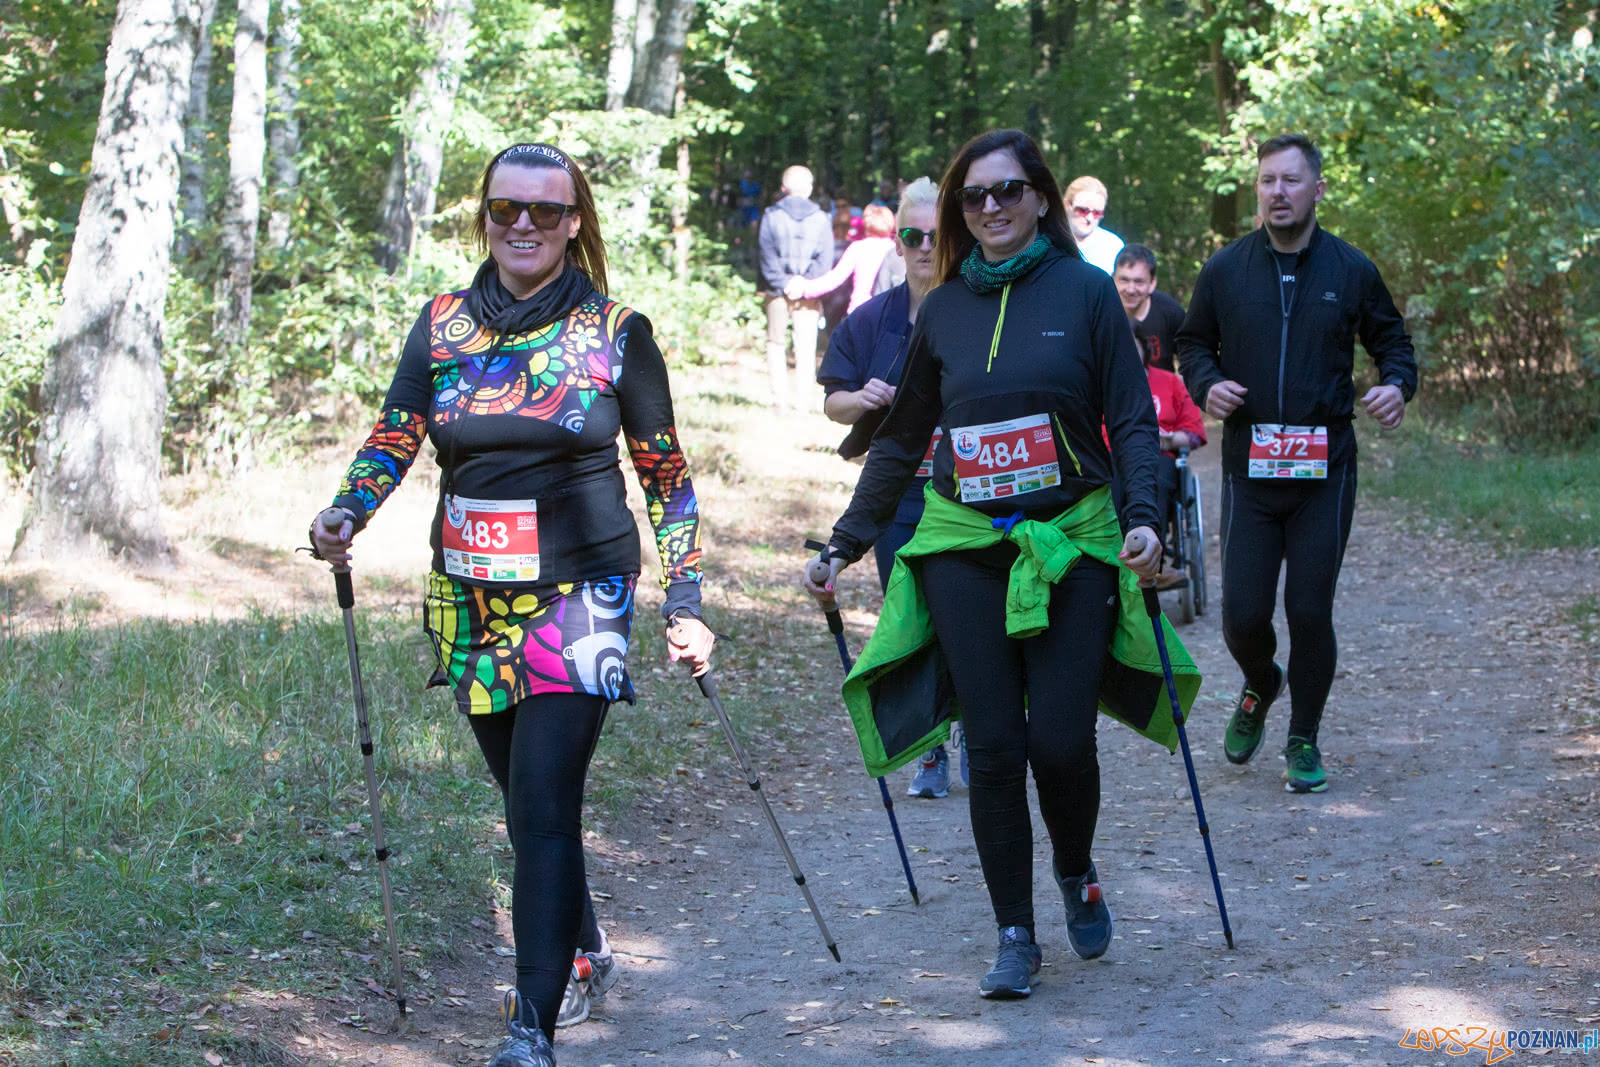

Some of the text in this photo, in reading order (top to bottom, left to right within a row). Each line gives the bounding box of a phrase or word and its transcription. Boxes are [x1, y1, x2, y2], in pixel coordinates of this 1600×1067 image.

[978, 437, 1030, 469] 484
[1269, 437, 1308, 457] 372
[462, 519, 509, 549] 483
